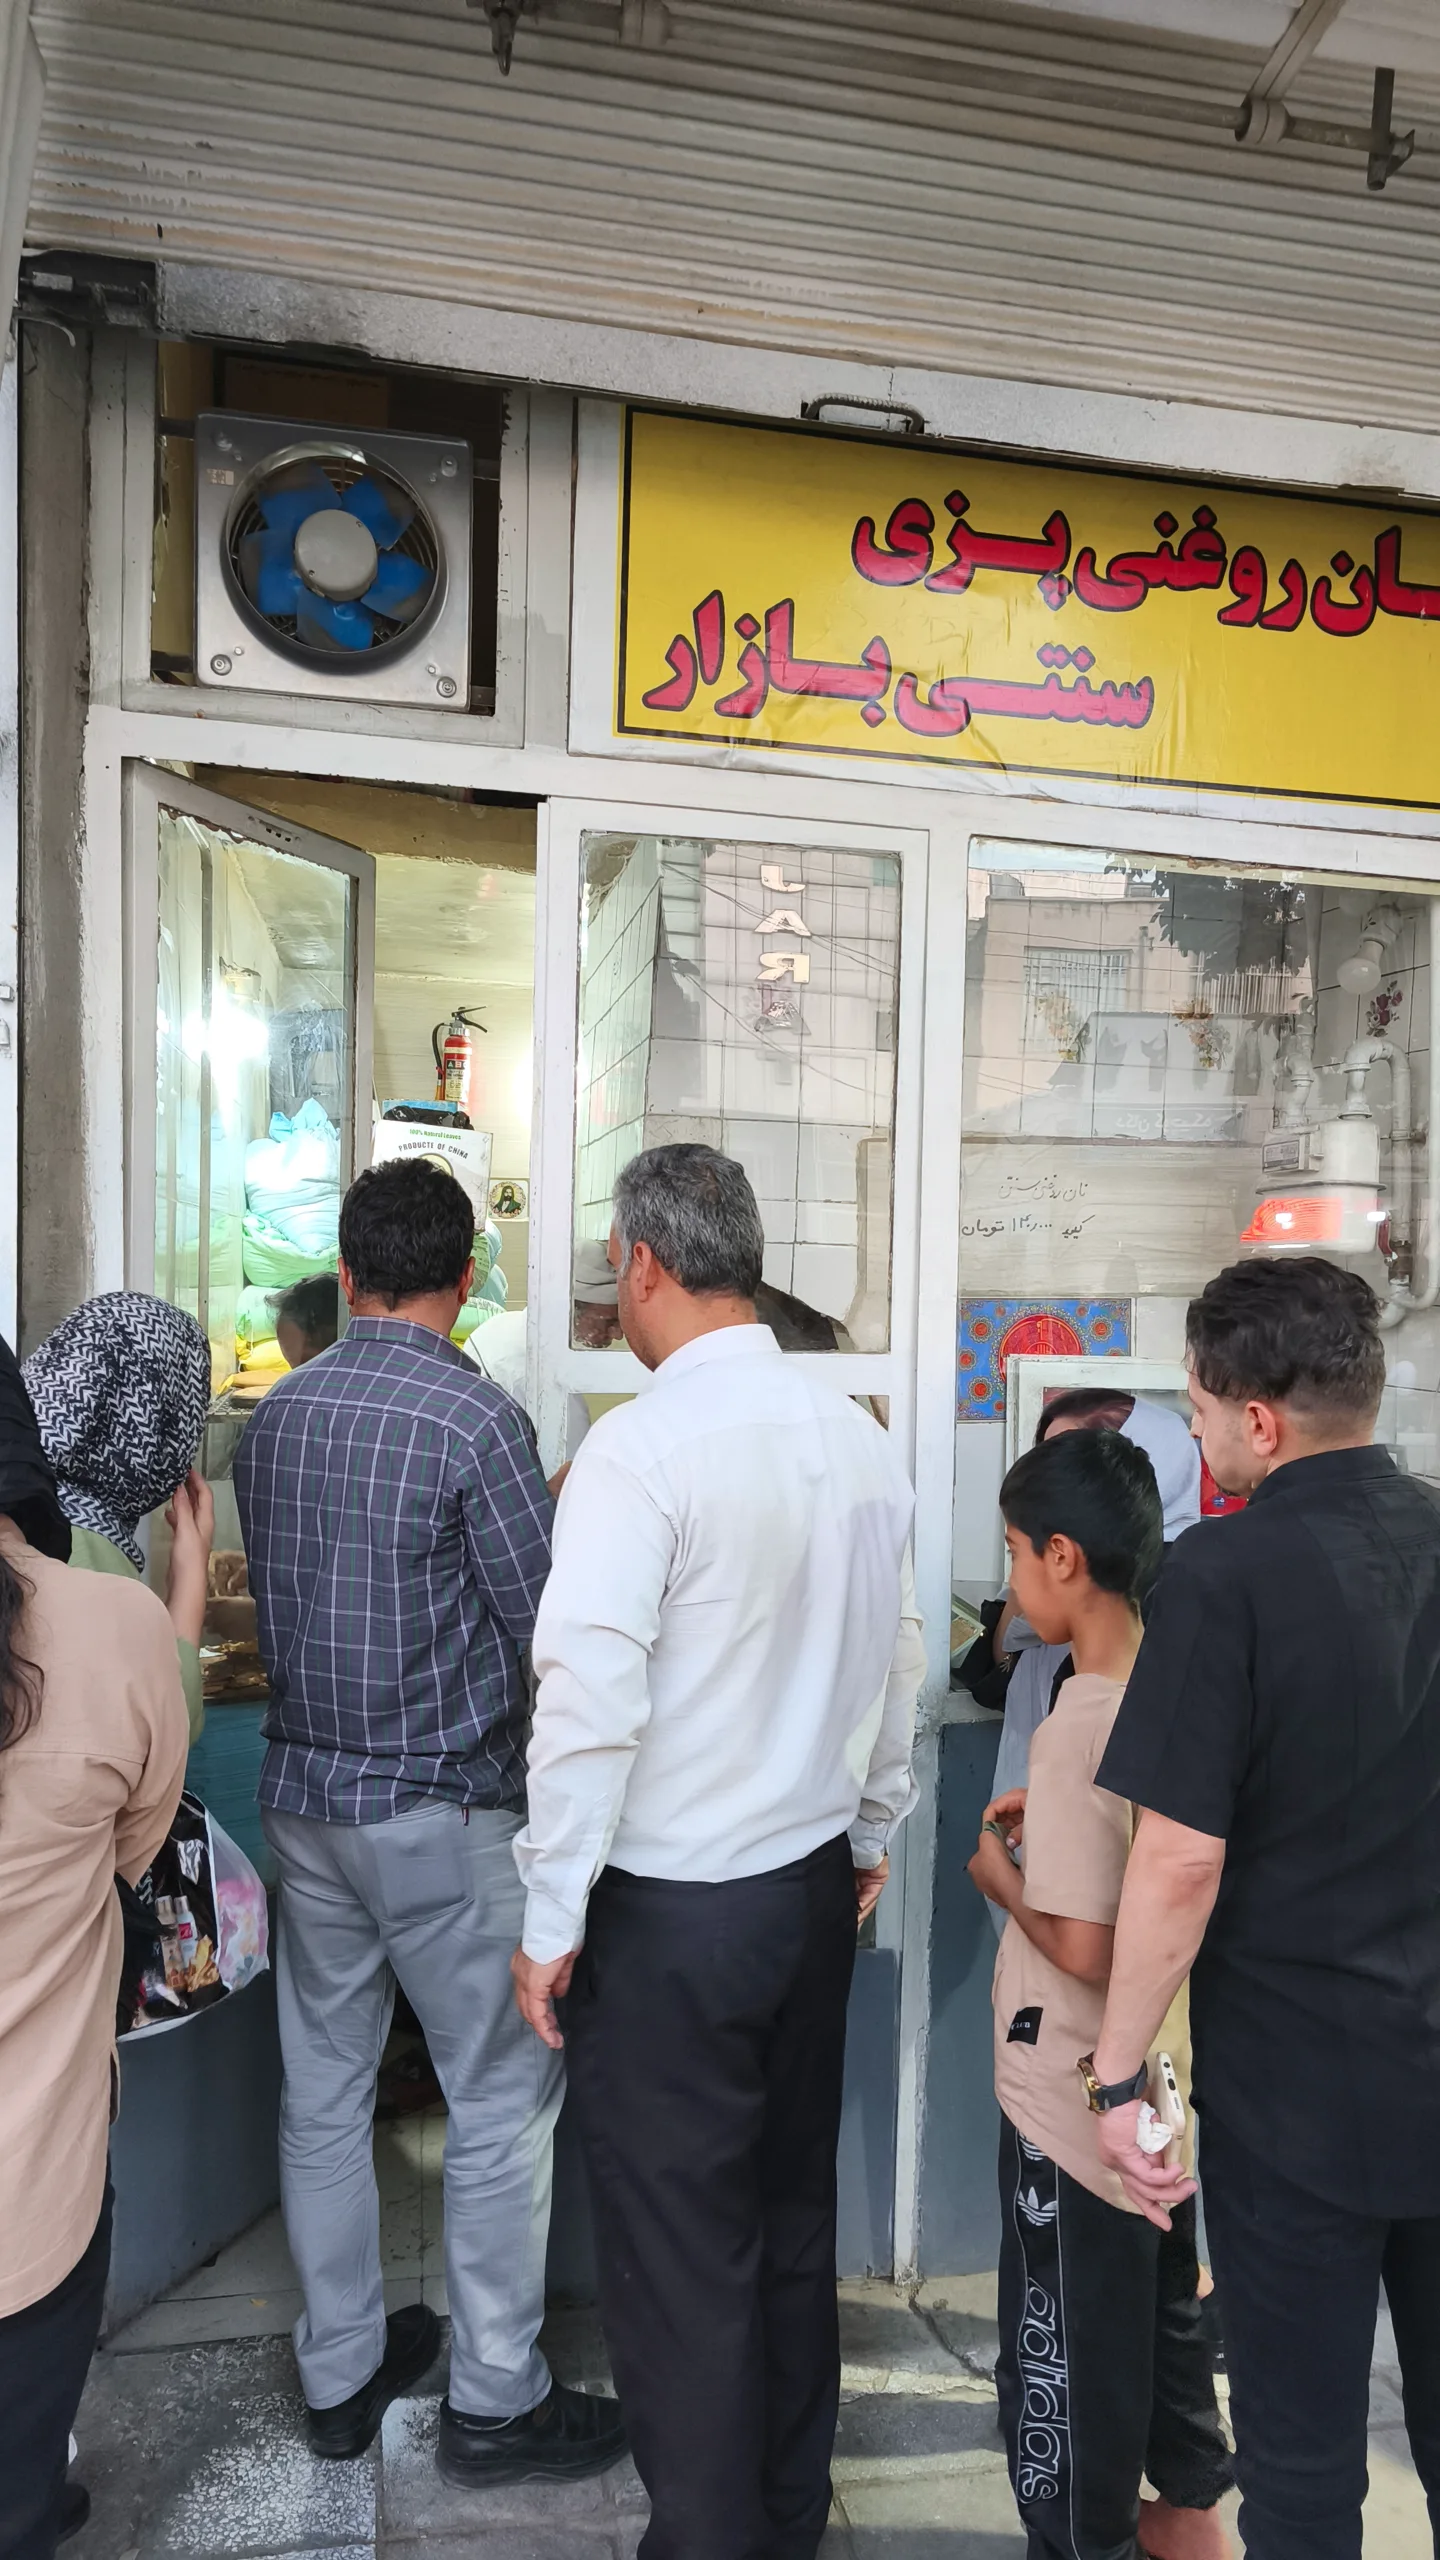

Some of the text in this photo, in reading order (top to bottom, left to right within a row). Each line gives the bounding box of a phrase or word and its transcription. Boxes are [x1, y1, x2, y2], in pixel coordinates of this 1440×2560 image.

[851, 488, 1440, 637] ان روغنی پزی
[641, 588, 1156, 737] سنتی بازار
[398, 1141, 434, 1152] PRODUCTE
[448, 1145, 469, 1160] CHINA
[1062, 1181, 1089, 1202] نان
[961, 1218, 1005, 1238] تومان
[1020, 2276, 1069, 2504] adidas
